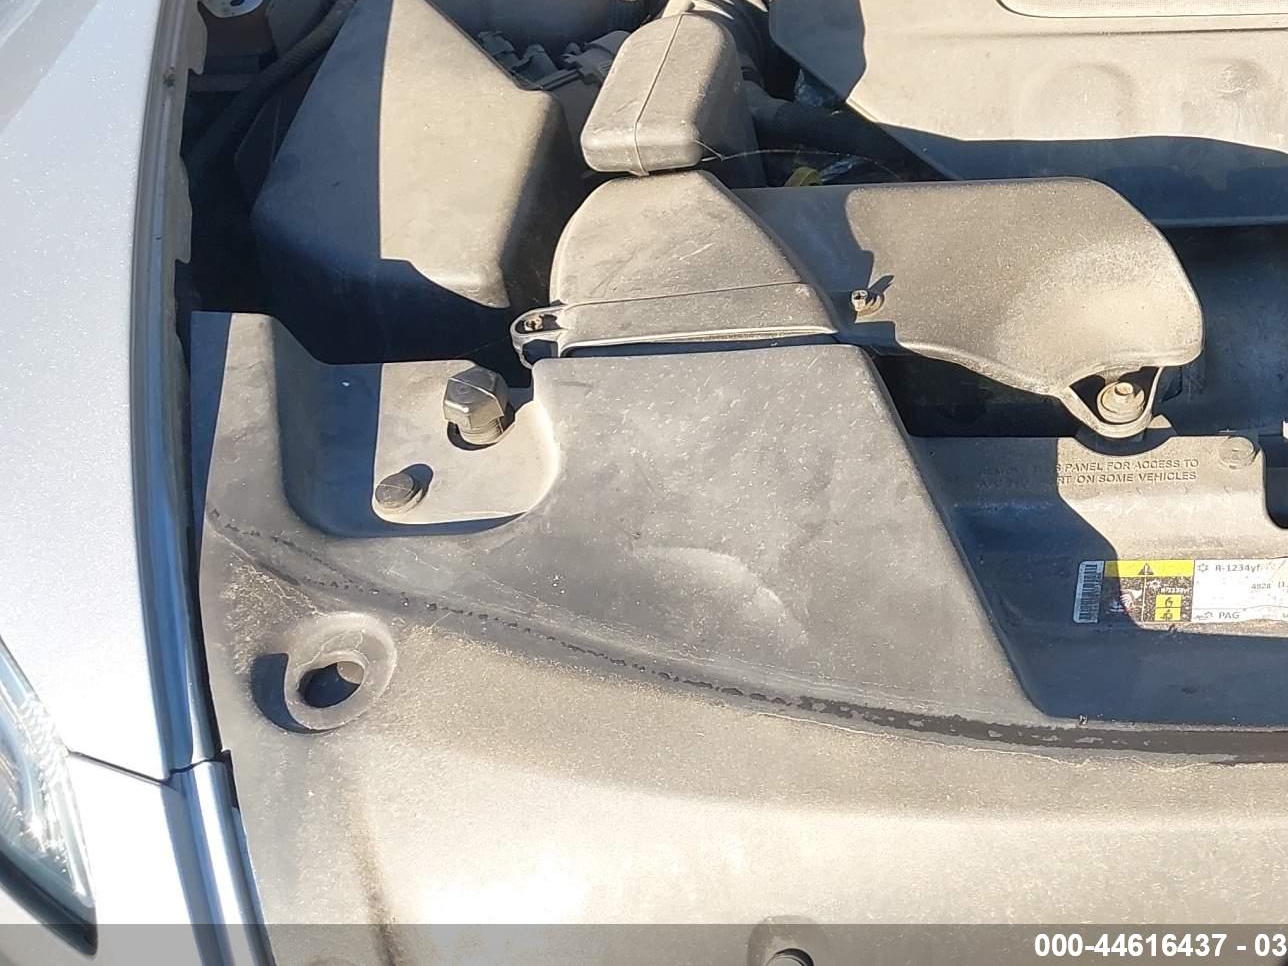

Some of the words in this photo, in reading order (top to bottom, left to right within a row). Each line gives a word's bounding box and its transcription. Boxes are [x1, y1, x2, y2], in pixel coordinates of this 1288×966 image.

[1064, 462, 1103, 472] PANEL
[1107, 461, 1131, 471] FOR
[1135, 459, 1181, 470] ACCESS
[1184, 458, 1199, 468] TO
[1077, 474, 1095, 484] ON
[1099, 473, 1133, 483] SOME
[1138, 471, 1197, 482] VEHICLES
[1215, 563, 1260, 573] R-1234yf
[1218, 611, 1240, 620] PAG
